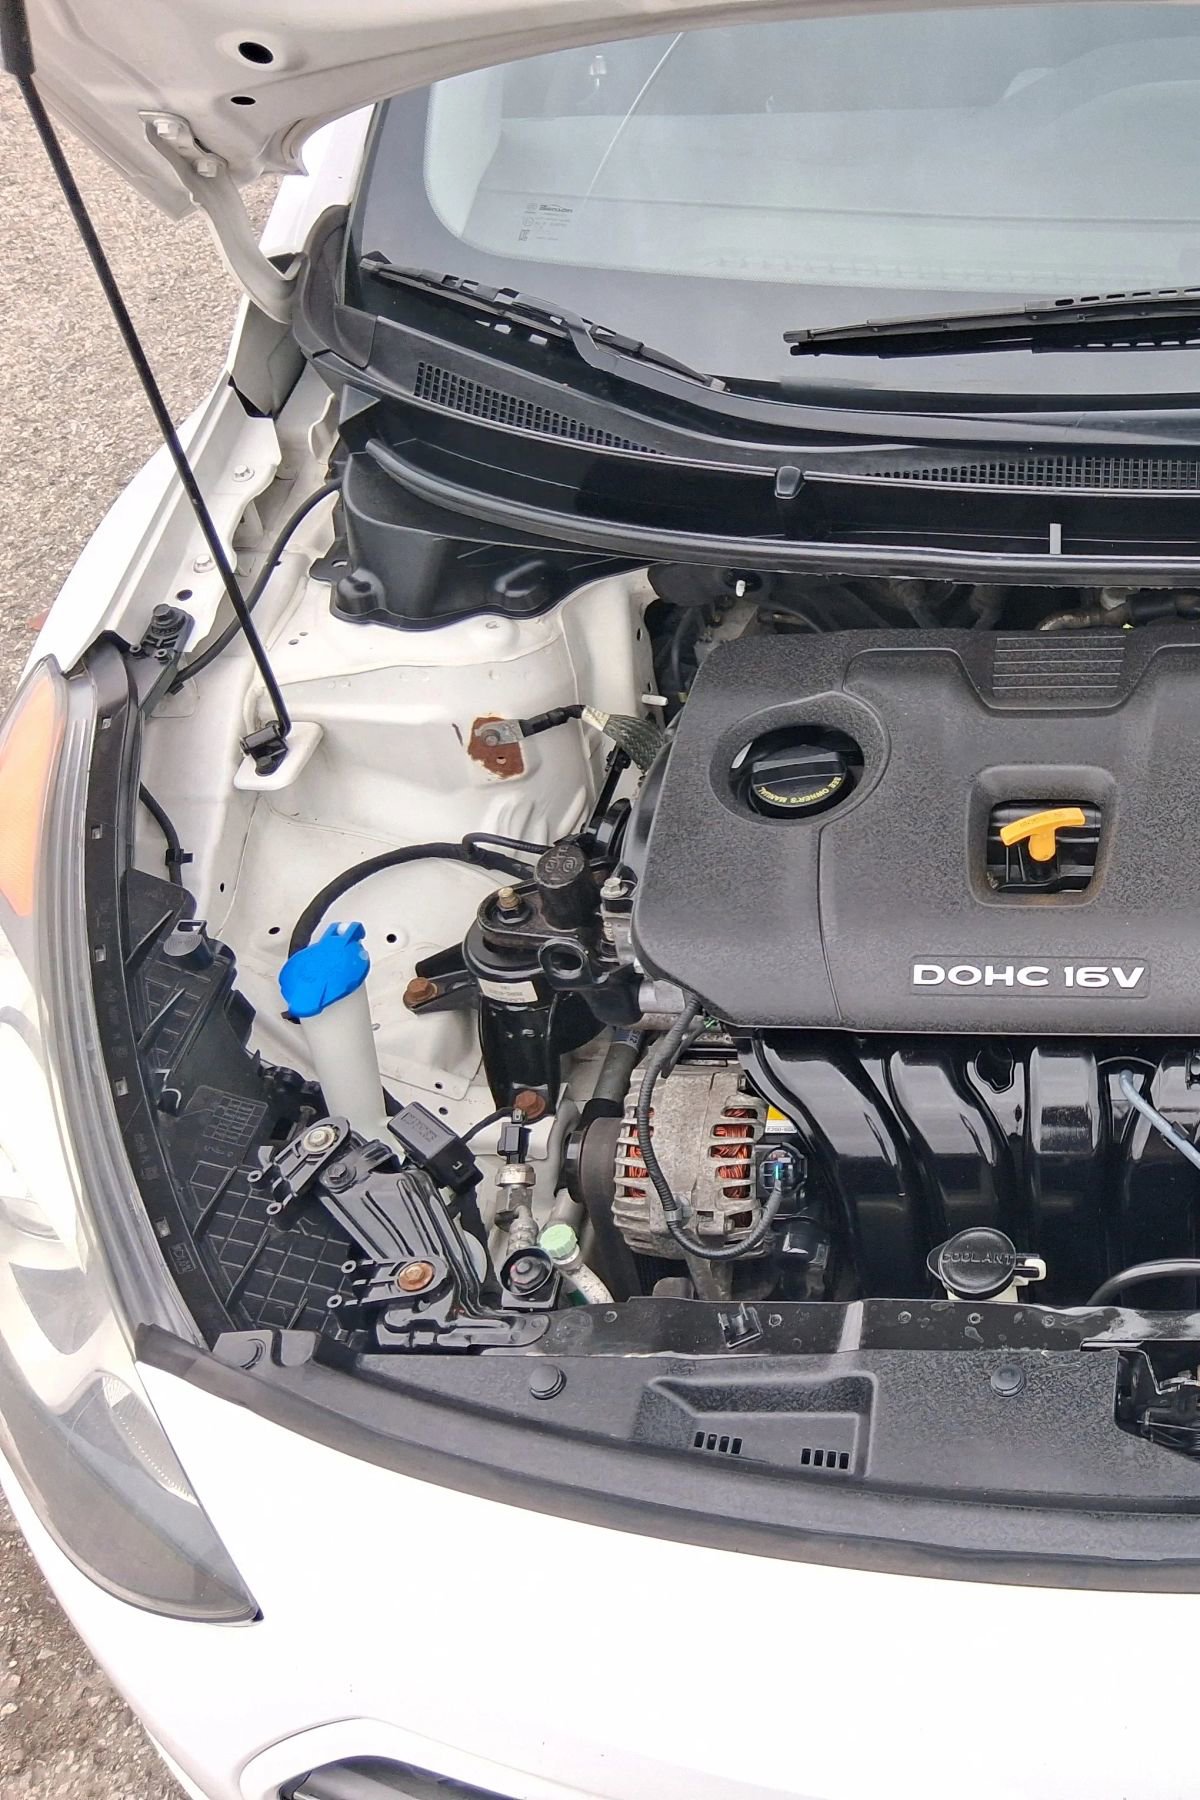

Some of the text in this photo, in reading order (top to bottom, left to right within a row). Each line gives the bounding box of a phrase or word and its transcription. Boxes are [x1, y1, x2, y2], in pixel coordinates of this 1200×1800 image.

[758, 786, 788, 804] MANUAL
[790, 788, 829, 804] OWNER'S
[913, 964, 1145, 989] DOHC 16V
[941, 1251, 1014, 1266] COOLANT
